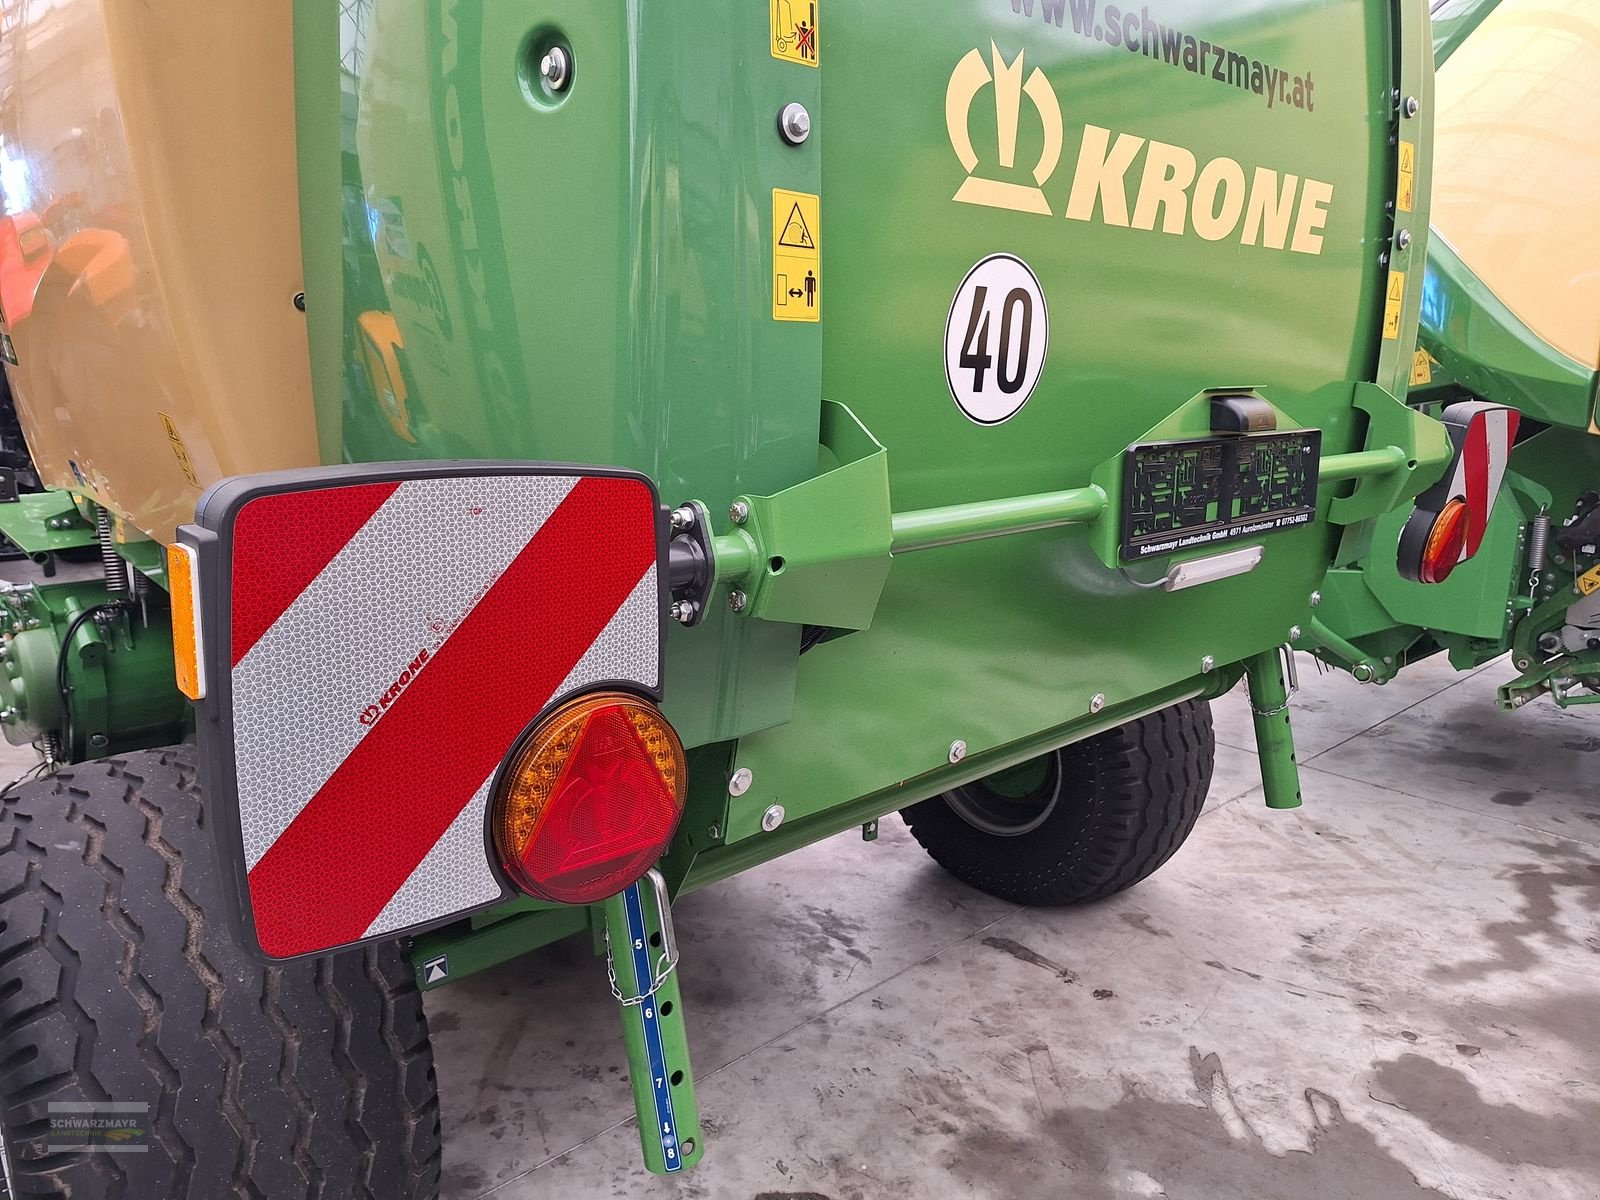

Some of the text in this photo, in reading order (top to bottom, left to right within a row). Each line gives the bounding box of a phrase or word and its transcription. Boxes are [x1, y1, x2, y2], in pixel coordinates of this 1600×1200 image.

[1065, 124, 1334, 255] KRONE
[959, 286, 1033, 394] 40
[1140, 541, 1179, 554] Schwarzmayr
[1179, 533, 1211, 547] Landtechnik
[1211, 530, 1228, 540] GmbH
[379, 648, 429, 709] KRONE
[635, 938, 643, 949] 5
[645, 1008, 653, 1019] 6
[655, 1077, 662, 1088] 7
[667, 1148, 675, 1159] 8
